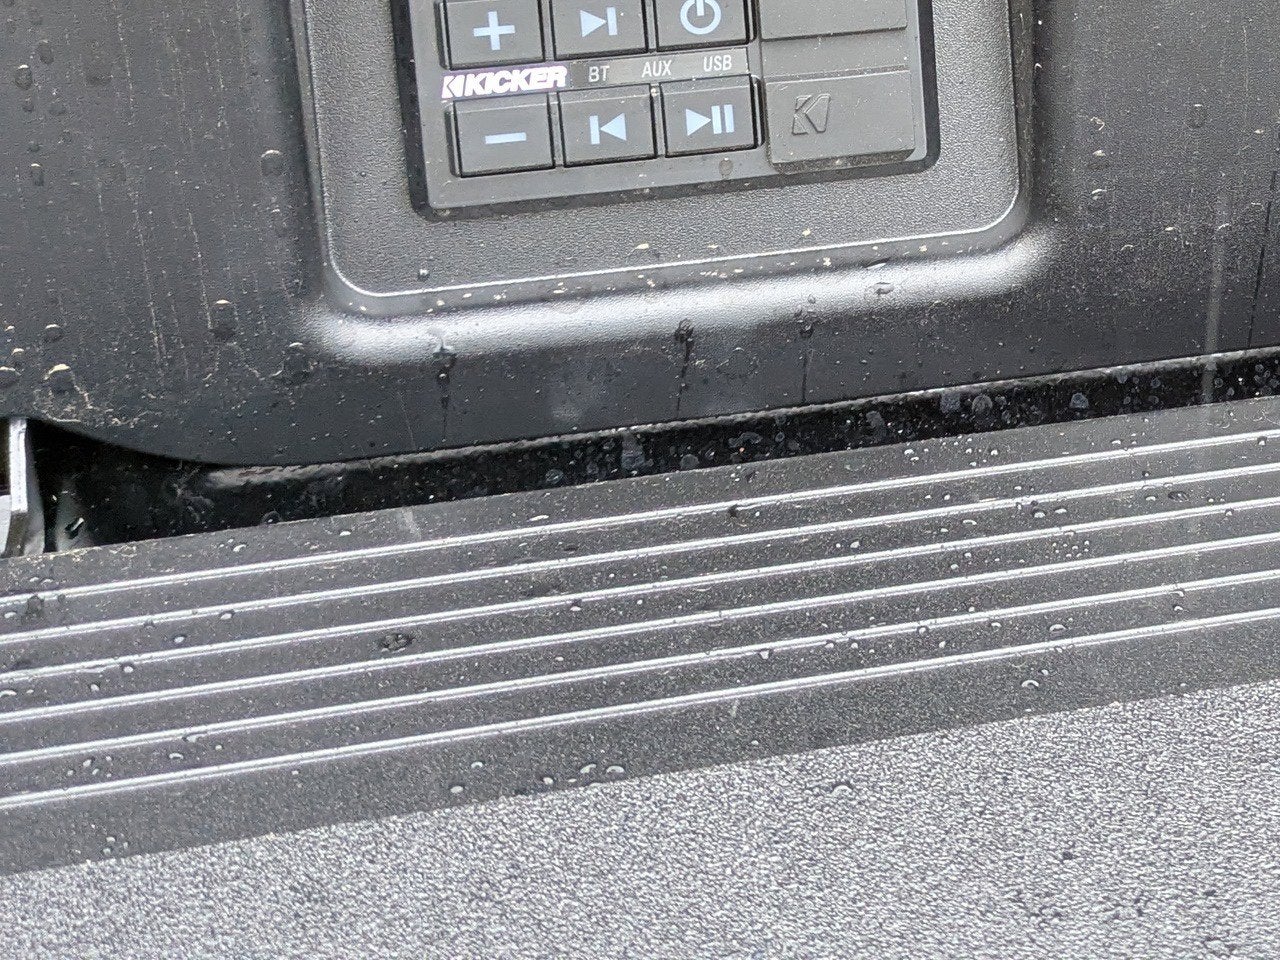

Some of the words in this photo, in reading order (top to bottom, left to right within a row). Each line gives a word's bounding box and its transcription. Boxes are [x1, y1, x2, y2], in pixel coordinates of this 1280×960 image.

[641, 59, 673, 78] AUX
[702, 54, 733, 72] USB
[464, 65, 568, 97] KICKER
[588, 65, 610, 83] BT
